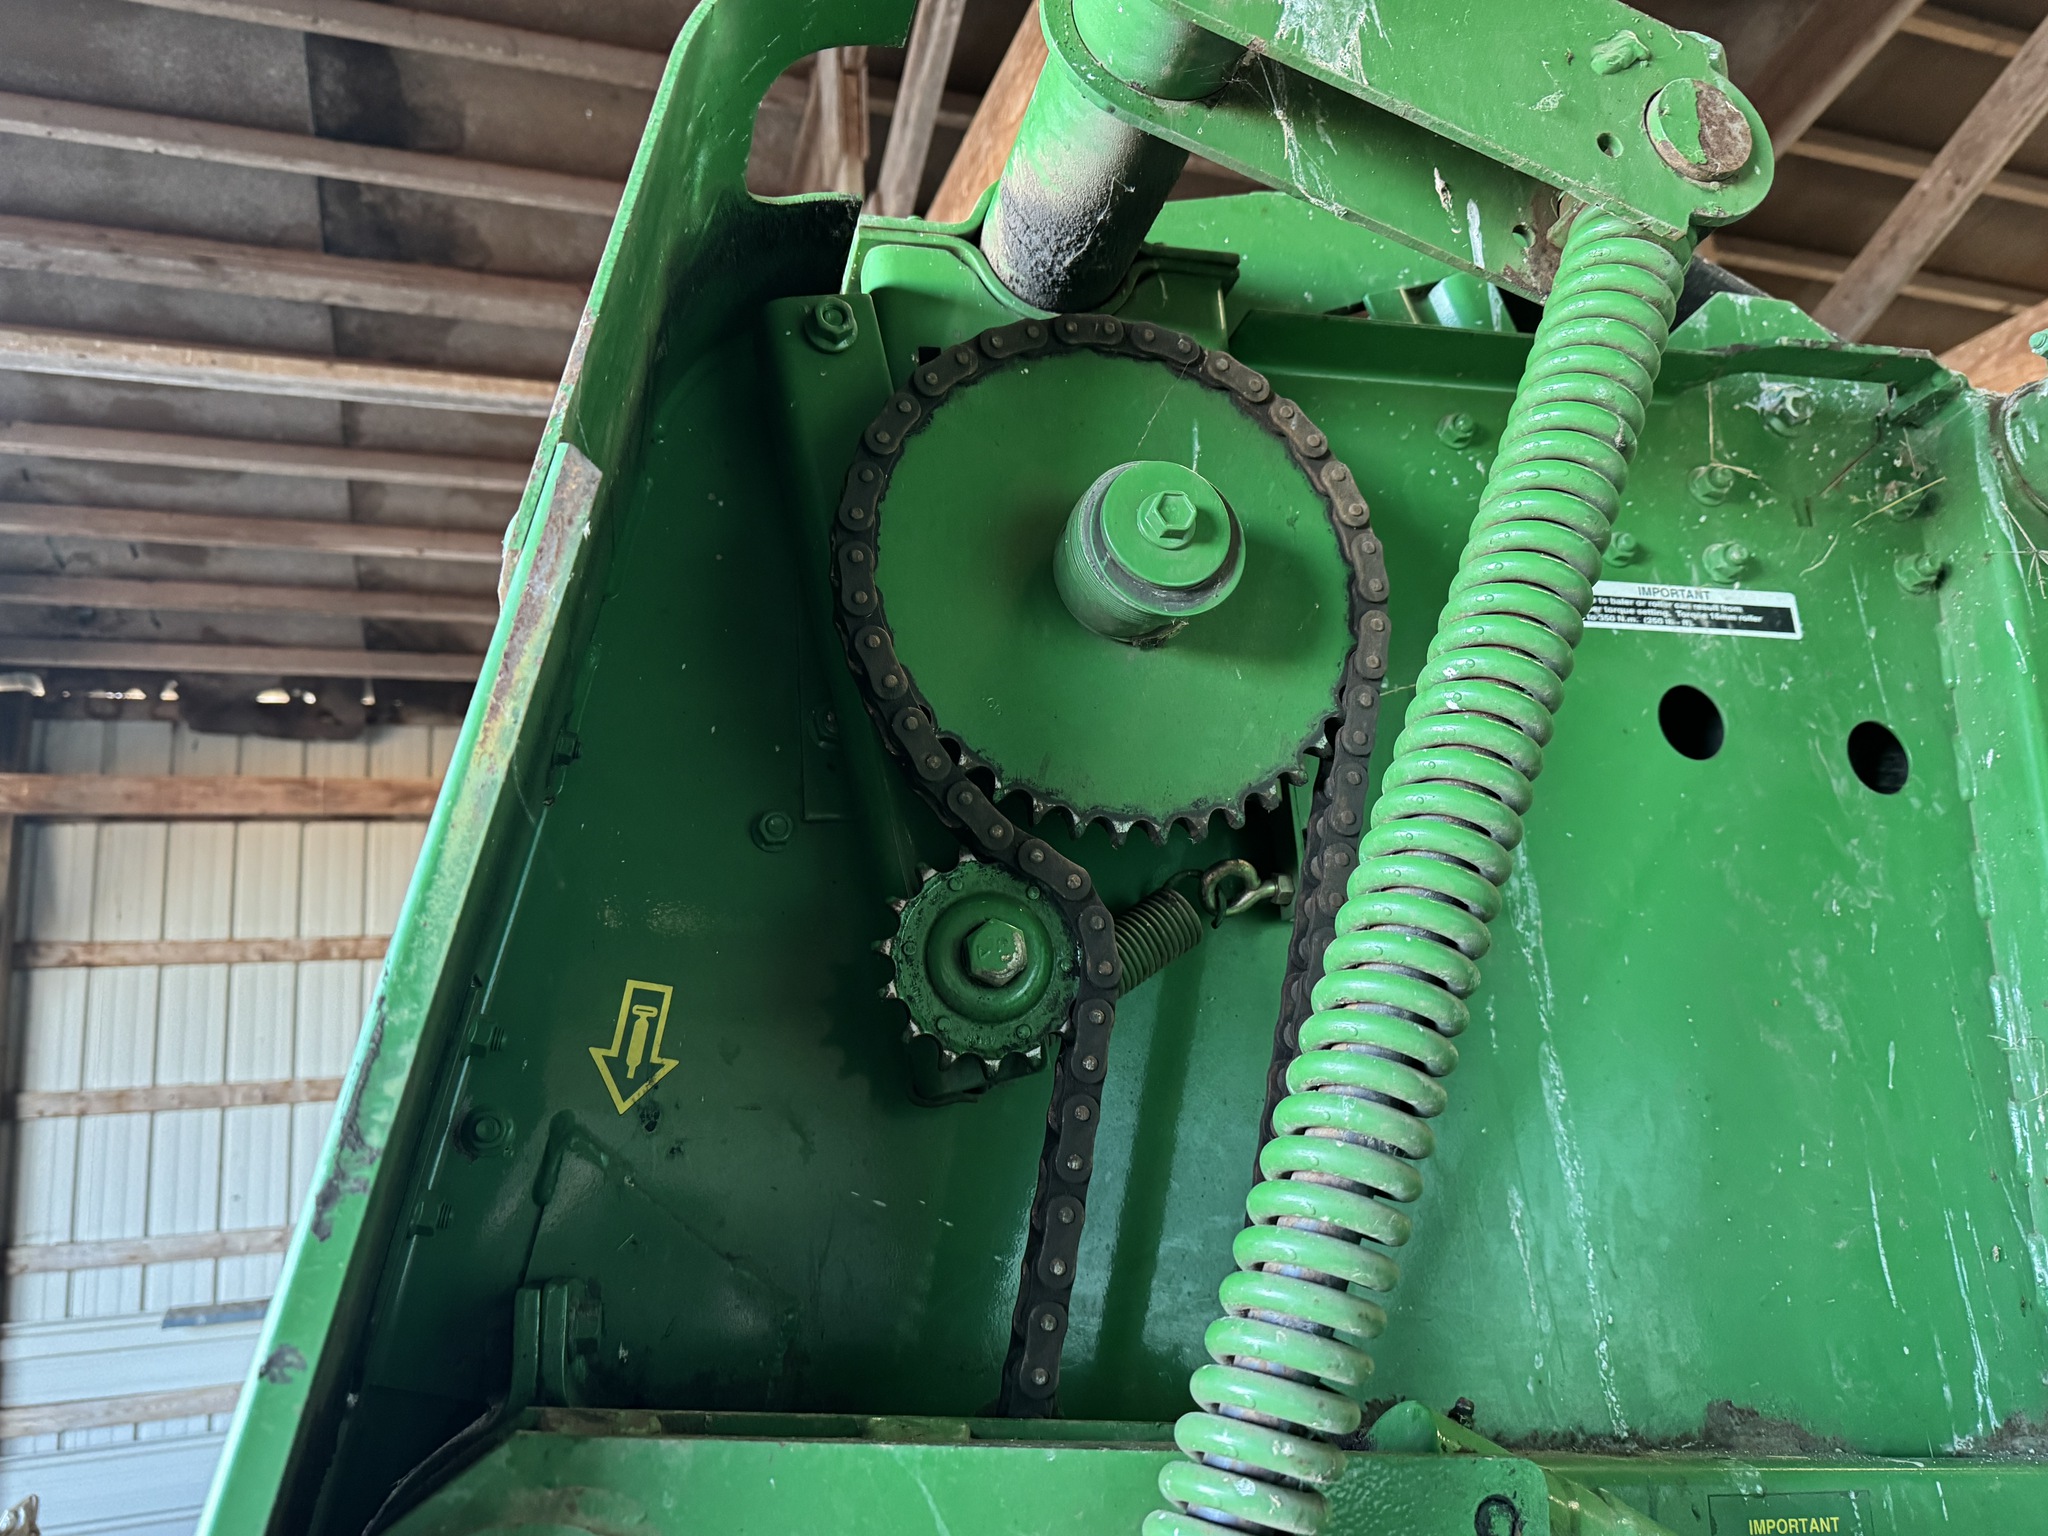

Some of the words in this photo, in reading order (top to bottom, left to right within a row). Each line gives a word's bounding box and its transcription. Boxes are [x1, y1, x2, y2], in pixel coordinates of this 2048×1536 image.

[1637, 586, 1709, 600] IMPORTANT
[1598, 597, 1609, 605] to
[1720, 604, 1744, 613] from
[1603, 606, 1635, 615] torque
[1738, 614, 1763, 623] roller
[1749, 1517, 1839, 1535] IMPORTANT
